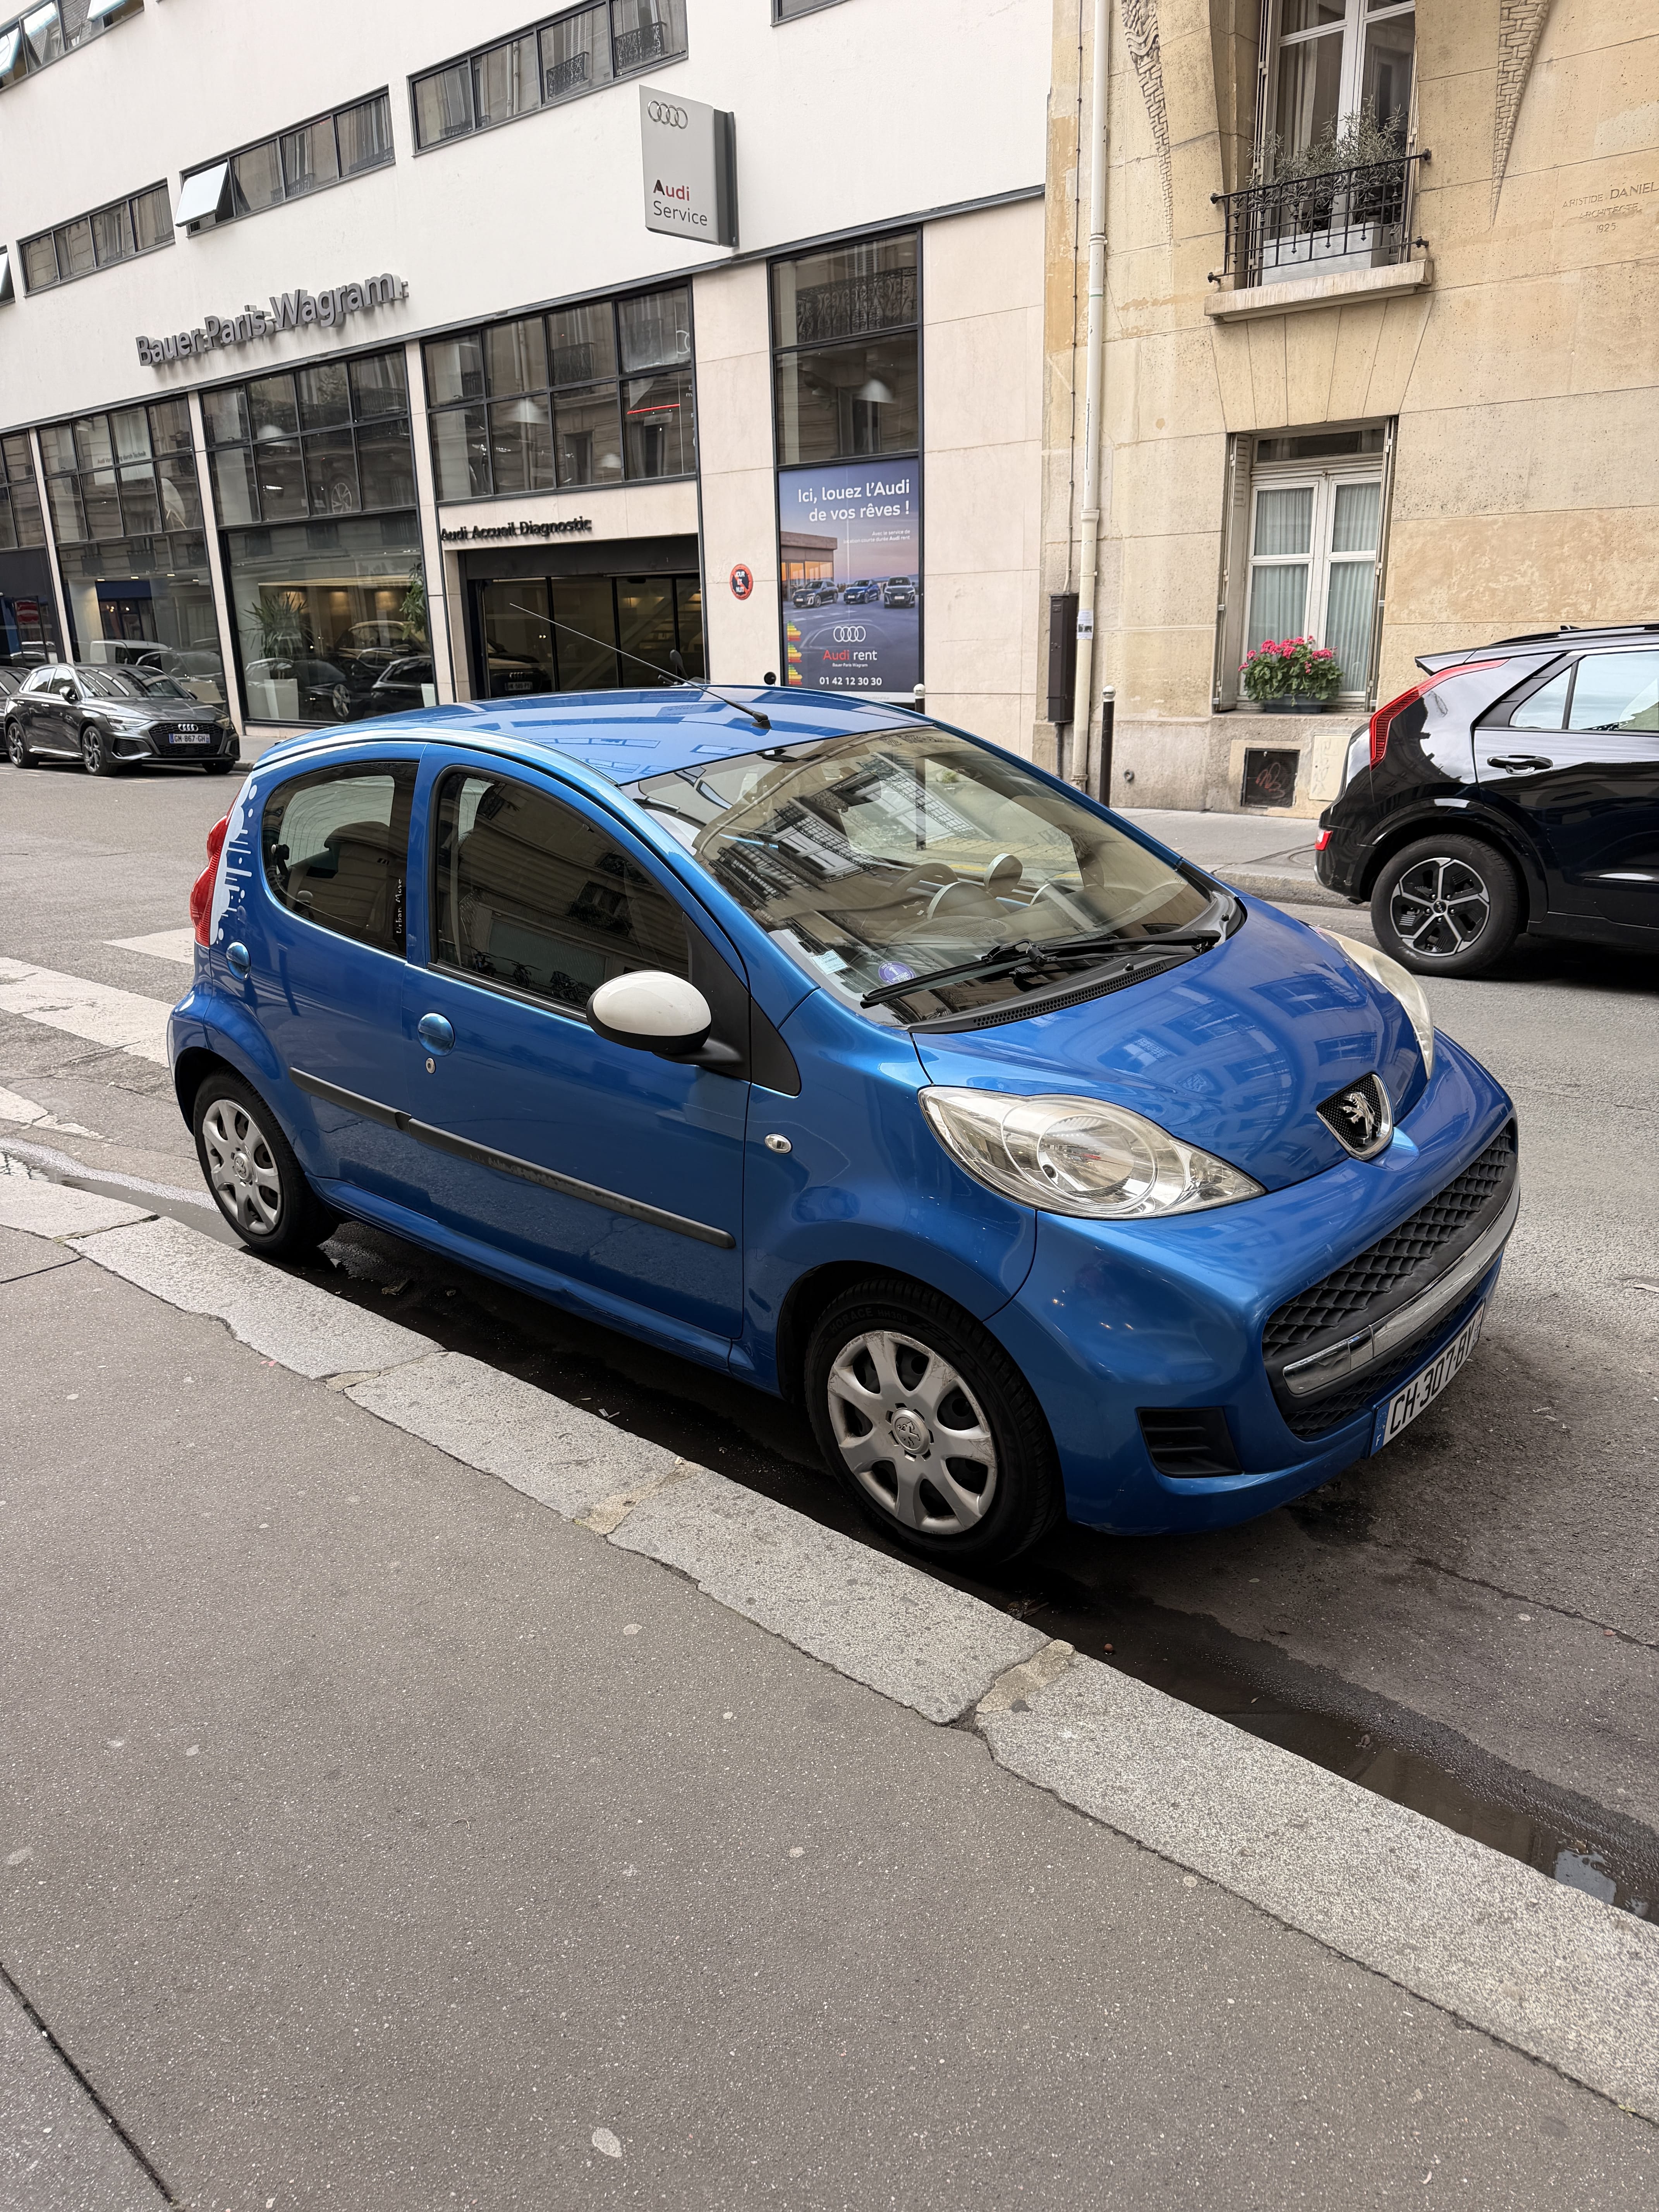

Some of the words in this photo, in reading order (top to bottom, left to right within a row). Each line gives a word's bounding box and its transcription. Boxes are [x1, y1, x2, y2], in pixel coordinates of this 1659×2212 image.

[653, 179, 690, 201] Audi
[1562, 194, 1604, 208] ARISTIDE
[1610, 182, 1659, 200] DANIEL
[653, 200, 708, 226] Service
[1596, 222, 1617, 234] 1925
[136, 328, 207, 367] Bauer
[204, 304, 273, 349] Paris
[269, 273, 403, 328] Wagram
[798, 488, 817, 504] Ici,
[822, 487, 862, 501] louez
[809, 508, 826, 522] de
[830, 508, 855, 520] vos
[860, 503, 900, 518] rêves
[905, 500, 909, 515] !
[441, 526, 468, 541] Audi
[472, 522, 517, 539] Accueil
[519, 516, 592, 537] Diagnostic
[823, 649, 850, 660] Audi
[853, 650, 878, 661] rent
[819, 677, 830, 685] 01
[832, 677, 843, 685] 42
[845, 677, 855, 685] 12
[857, 677, 869, 685] 30
[871, 677, 883, 686] 30
[1376, 1434, 1381, 1447] F
